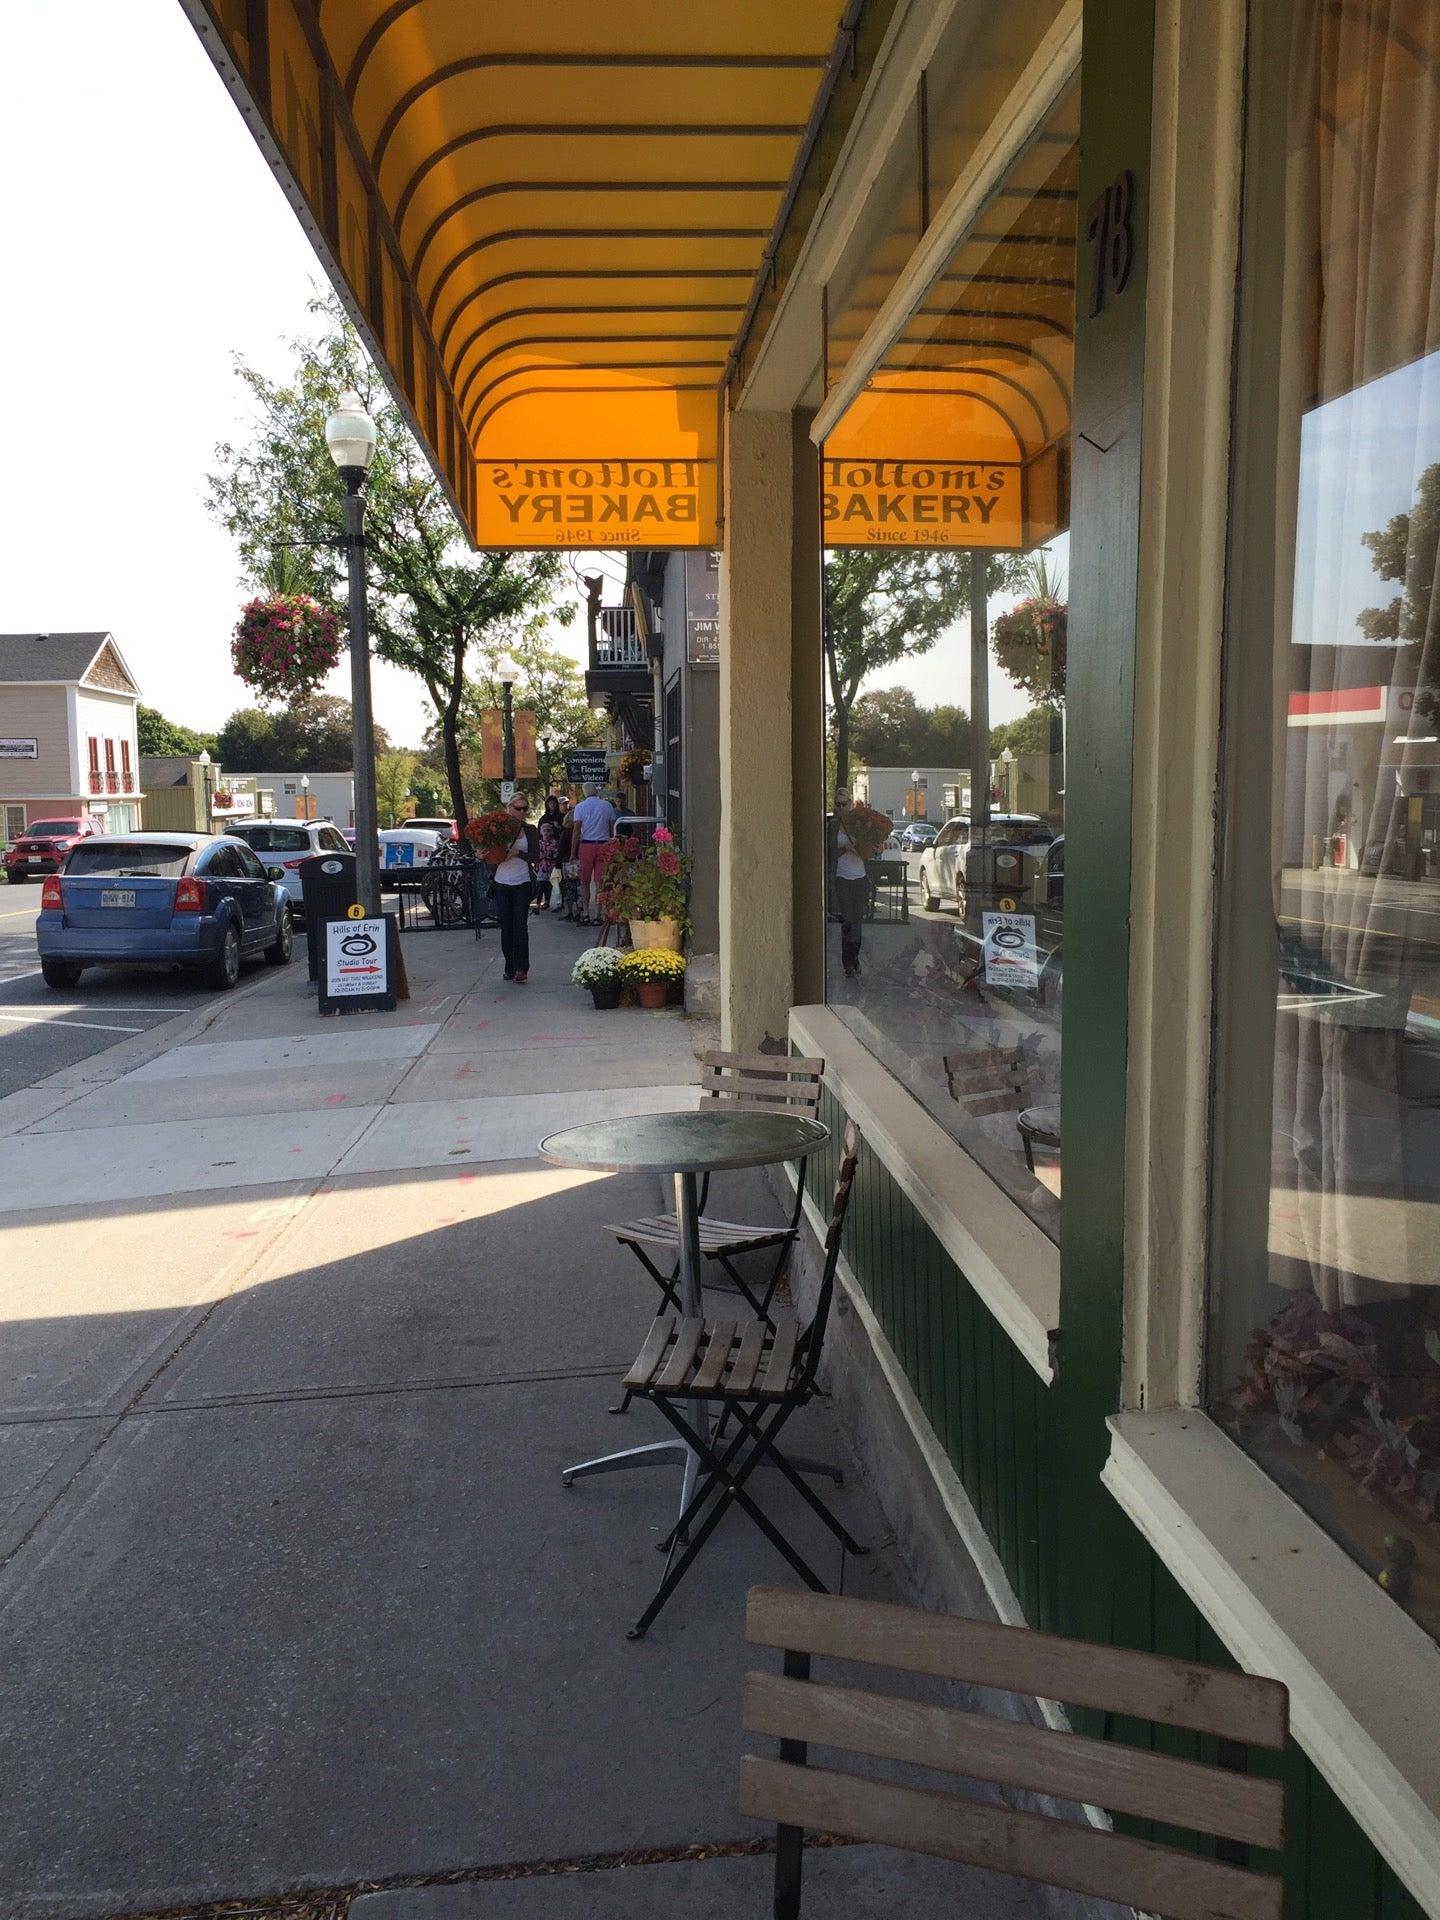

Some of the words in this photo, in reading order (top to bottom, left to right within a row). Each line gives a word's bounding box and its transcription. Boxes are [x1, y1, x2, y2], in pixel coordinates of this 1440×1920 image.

[824, 493, 1000, 524] BAKERY
[867, 528, 907, 542] Since
[913, 529, 949, 543] 1946
[694, 622, 712, 631] JIM
[353, 907, 360, 917] 6
[333, 925, 351, 934] Hills
[353, 924, 361, 932] of
[364, 923, 380, 932] Erin
[337, 959, 360, 967] Studio
[362, 957, 378, 965] Tour
